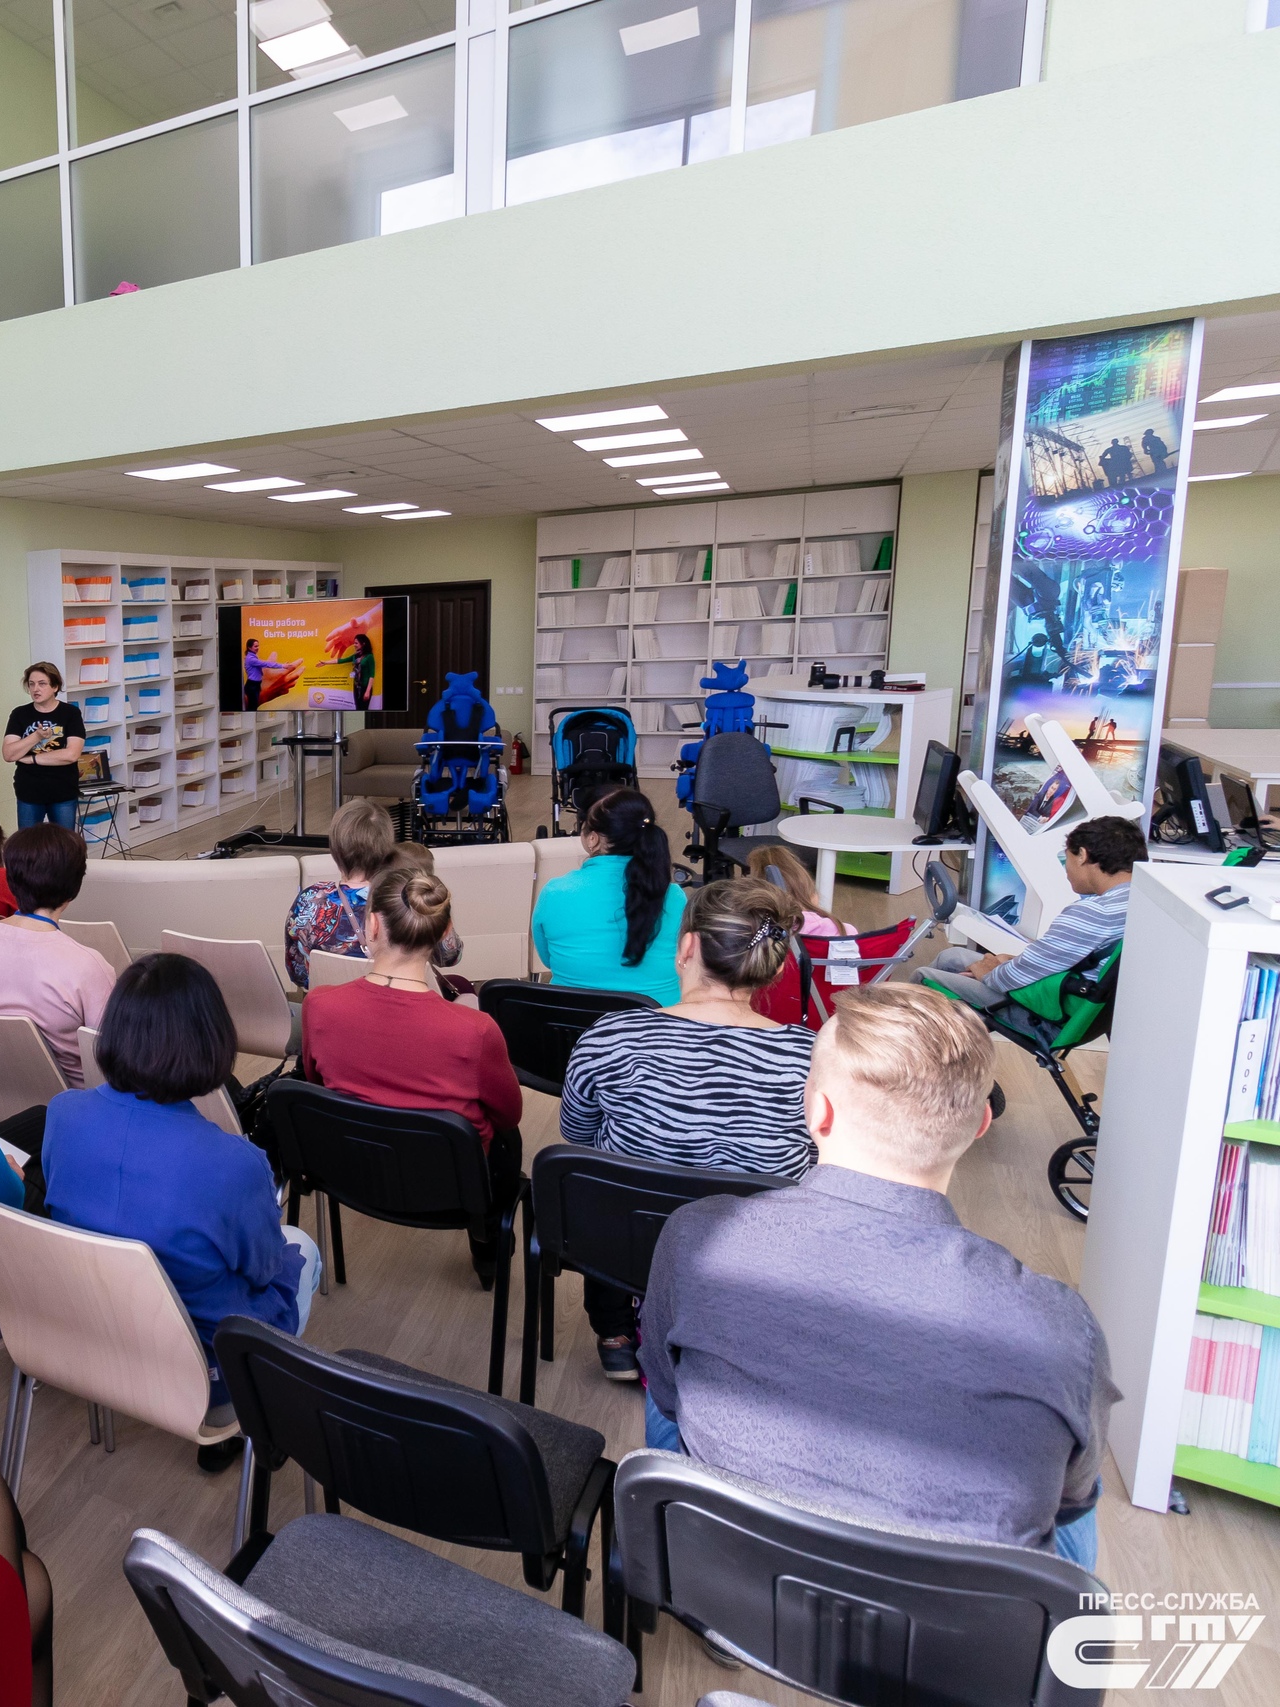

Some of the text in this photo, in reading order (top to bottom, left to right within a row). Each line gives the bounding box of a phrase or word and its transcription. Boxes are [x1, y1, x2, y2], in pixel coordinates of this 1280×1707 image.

[249, 618, 306, 628] Наша работа
[263, 629, 285, 638] быть
[1242, 1033, 1256, 1093] 2006
